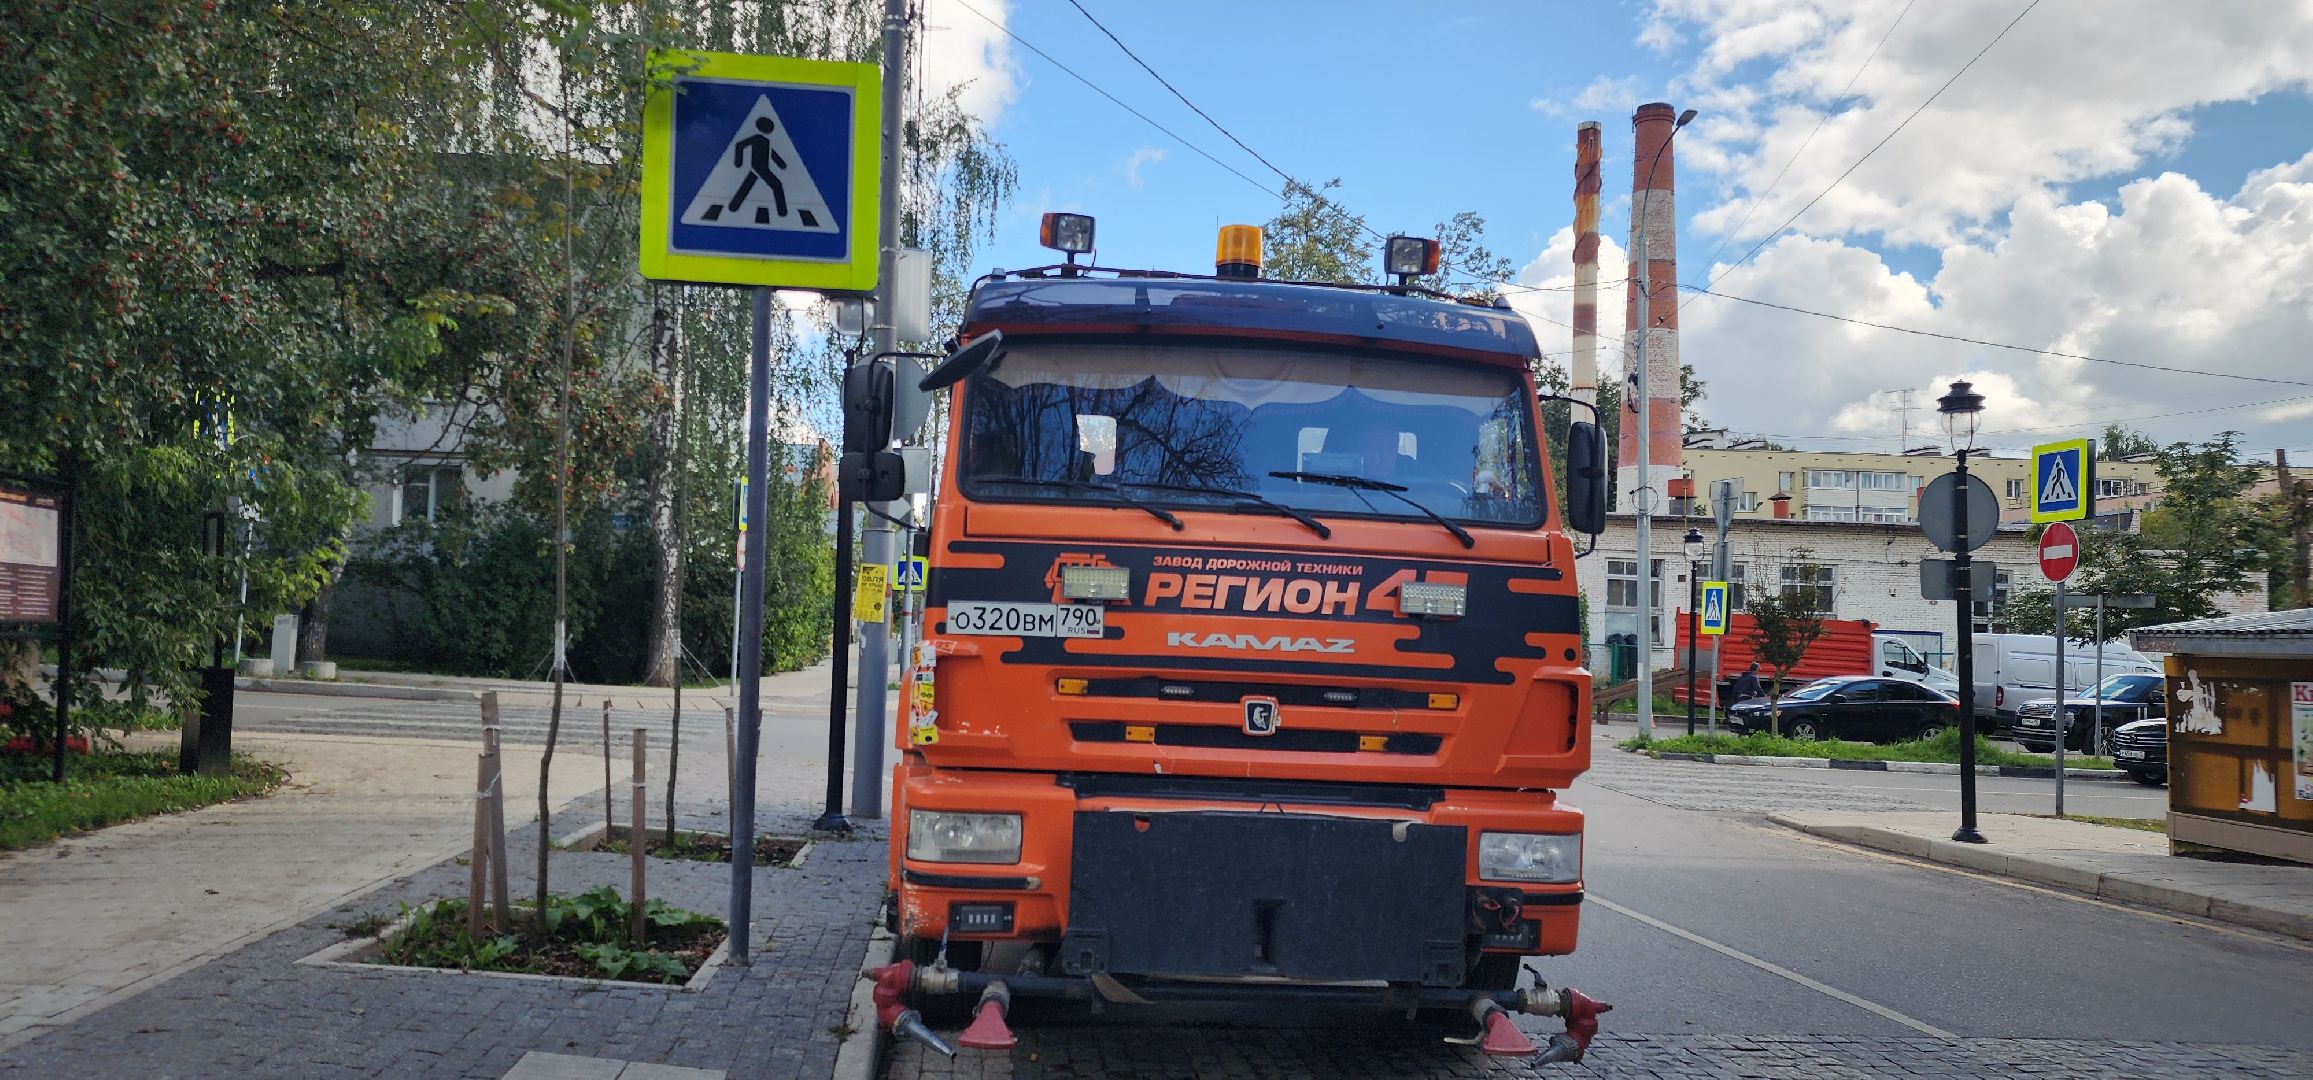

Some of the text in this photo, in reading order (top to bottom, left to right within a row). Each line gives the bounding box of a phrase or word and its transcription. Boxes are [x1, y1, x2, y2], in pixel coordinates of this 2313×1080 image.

[1153, 556, 1363, 576] ЗАВОД ДОРОЖНОЙ ТЕХНИКИ
[1143, 571, 1361, 616] РЕГИОН
[1059, 607, 1097, 627] 790
[1067, 626, 1086, 635] RUS
[1167, 631, 1355, 654] KAMAZ
